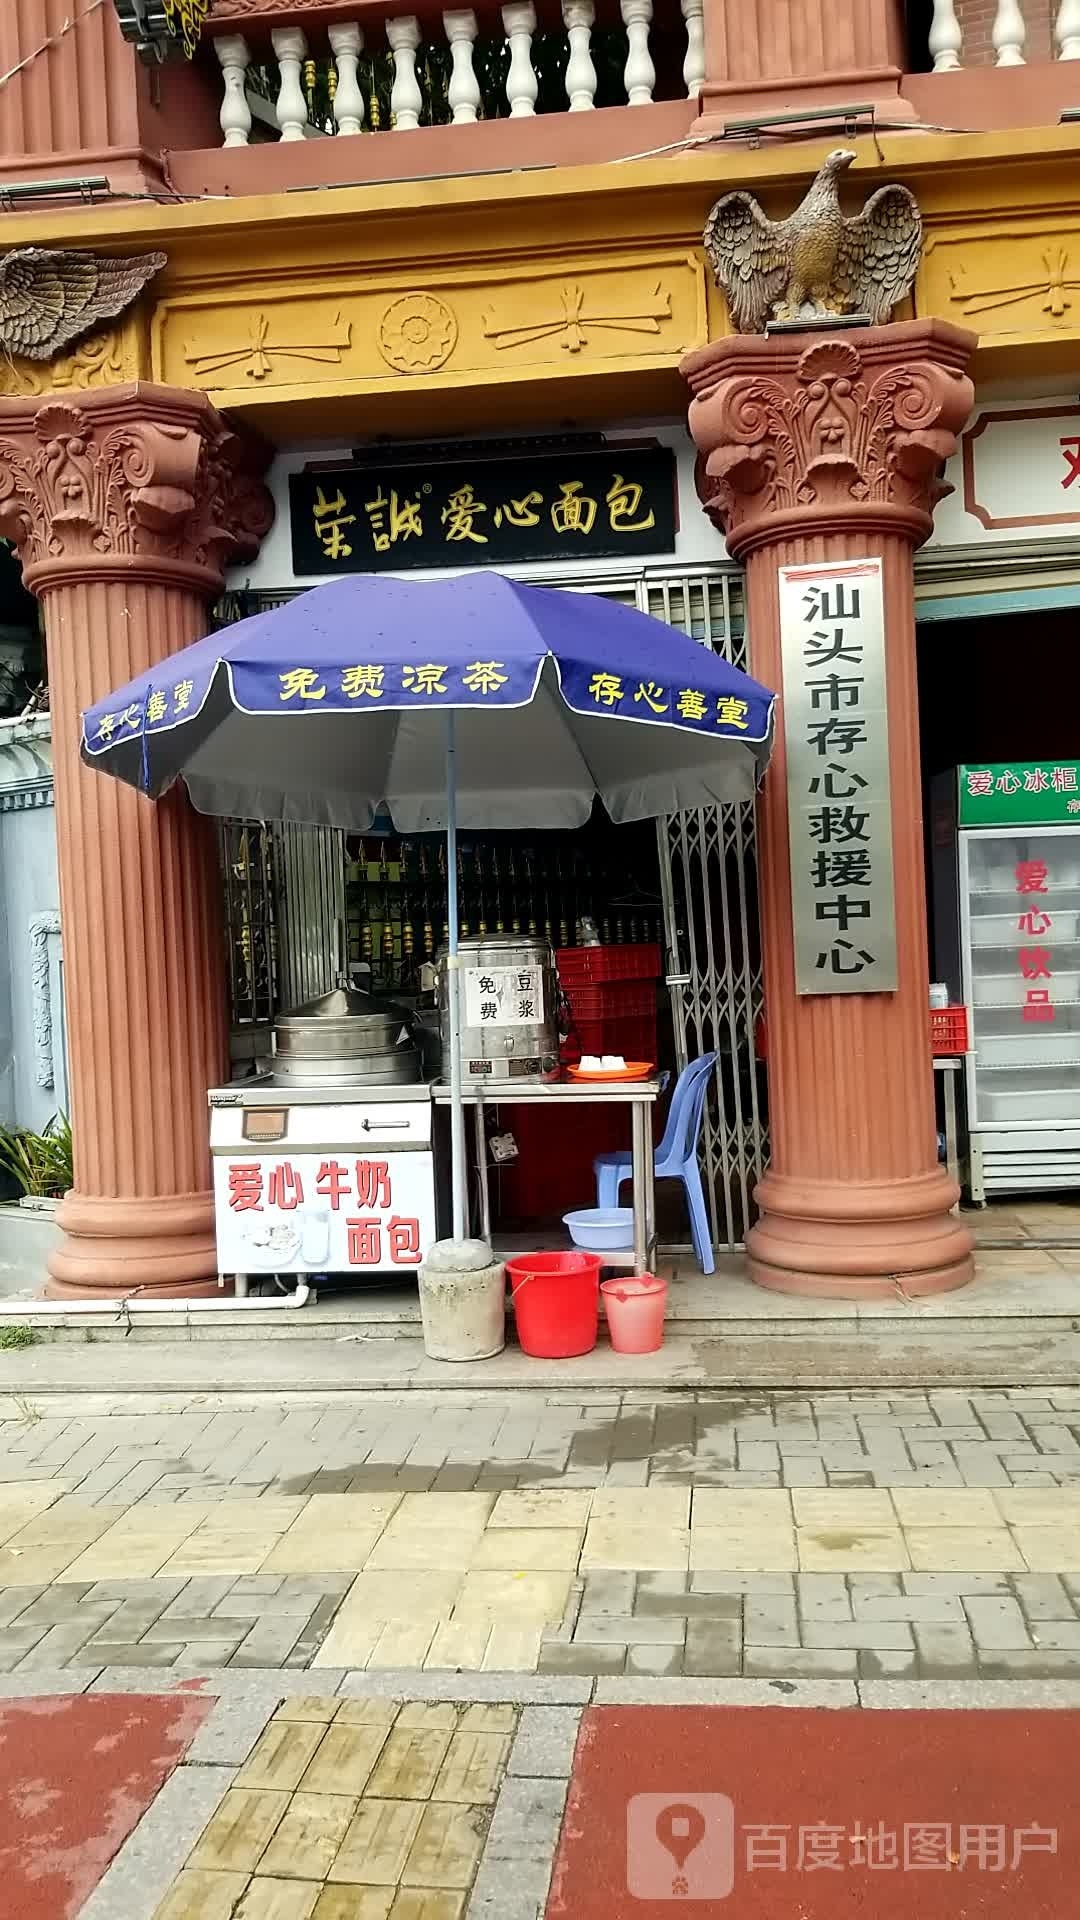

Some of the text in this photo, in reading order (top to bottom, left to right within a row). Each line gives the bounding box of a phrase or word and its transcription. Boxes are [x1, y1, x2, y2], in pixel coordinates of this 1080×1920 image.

[279, 661, 509, 700] 免费凉茶
[588, 672, 750, 730] 存心善堂
[99, 679, 193, 741] 存心善堂
[801, 583, 877, 975] 汕头市存心救援中心
[967, 767, 1079, 796] 爱心冰柜
[1015, 860, 1056, 1023] 爱心饮品
[228, 1159, 392, 1212] 爱心牛奶
[345, 1214, 423, 1265] 面包
